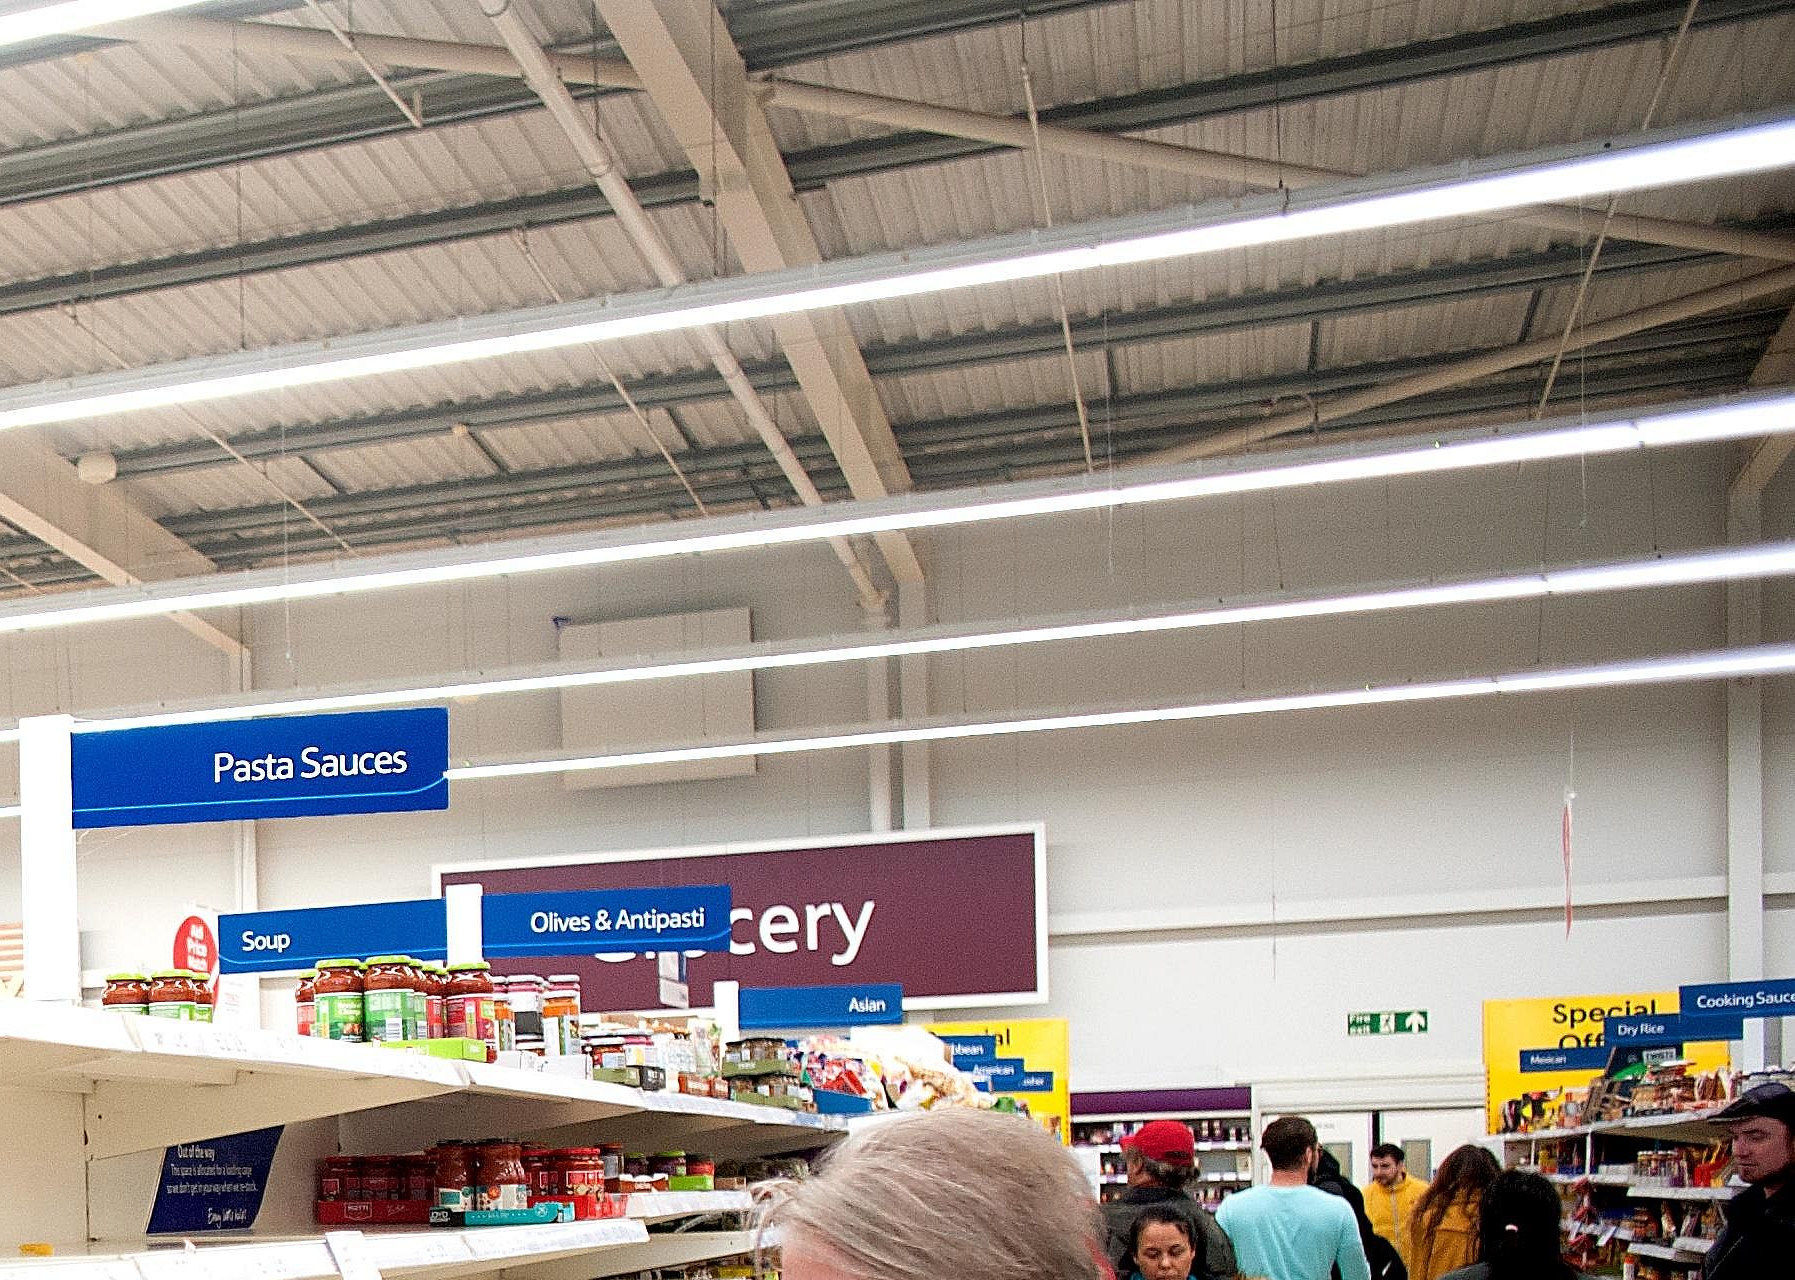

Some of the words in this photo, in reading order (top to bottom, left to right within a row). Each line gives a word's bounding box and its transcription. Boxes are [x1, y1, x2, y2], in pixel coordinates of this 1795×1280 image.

[214, 752, 294, 783] Pasta
[300, 746, 408, 779] Sauces
[530, 909, 591, 934] Olives
[595, 909, 612, 931] &
[615, 906, 705, 934] Antipasti
[241, 930, 291, 952] Soup
[848, 996, 886, 1014] Asian
[1696, 992, 1754, 1010] Cooking
[1617, 1023, 1639, 1037] Dry
[1641, 1022, 1665, 1035] Rice
